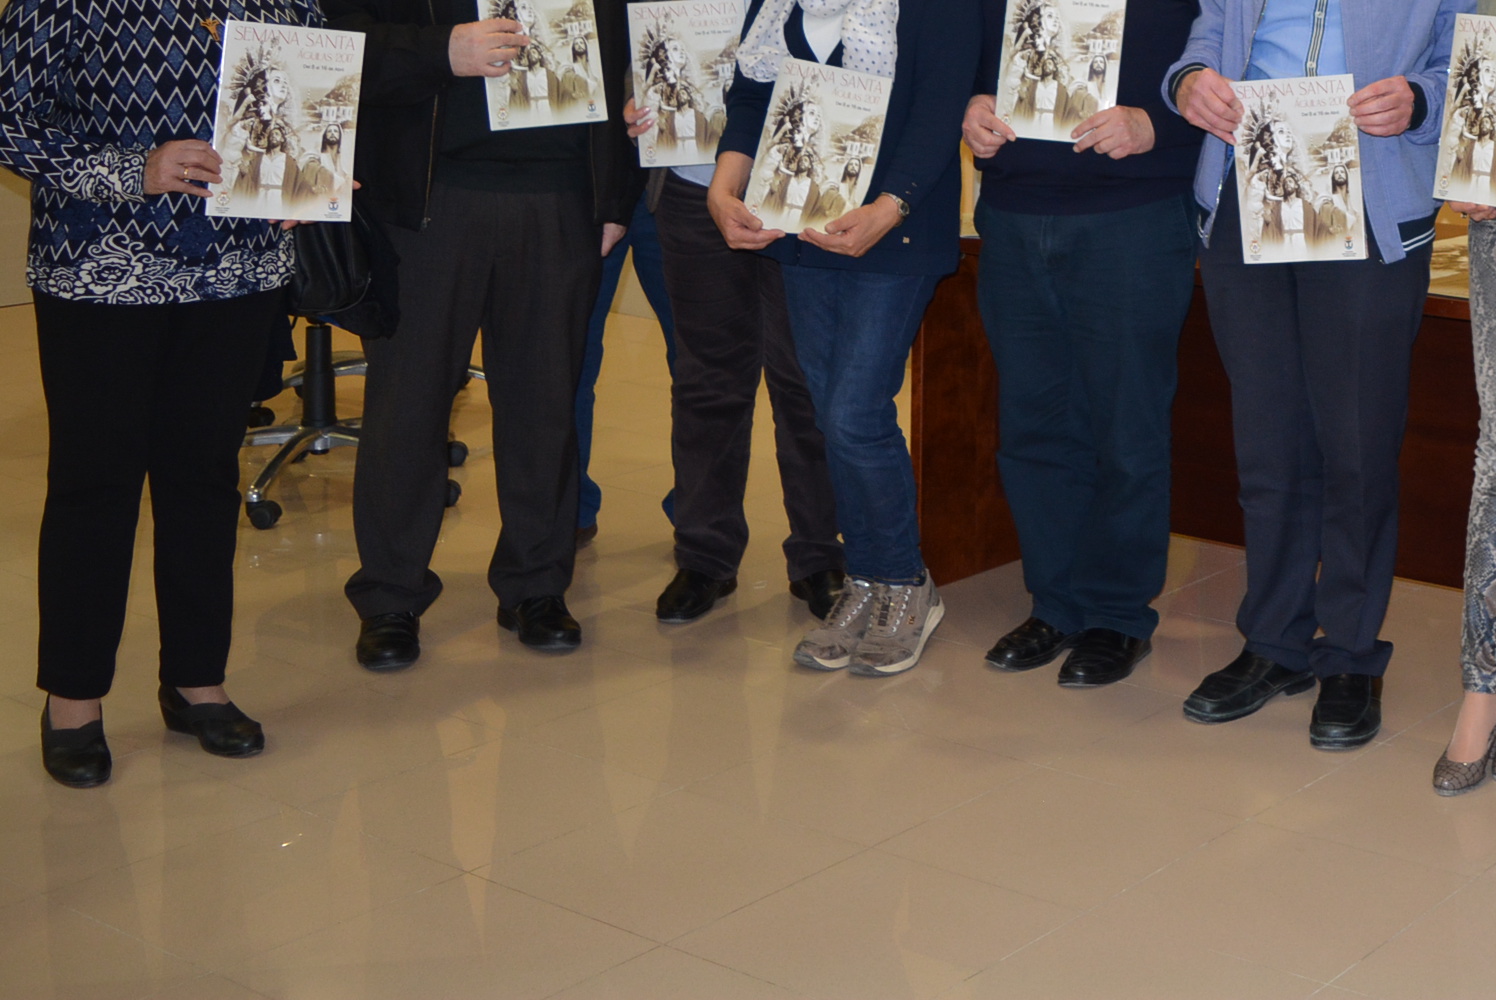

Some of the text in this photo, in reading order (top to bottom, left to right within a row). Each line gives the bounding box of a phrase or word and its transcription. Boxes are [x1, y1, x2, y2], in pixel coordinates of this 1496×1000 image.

[234, 26, 355, 51] SEMANA SANTA
[1236, 80, 1346, 99] SEMANA SANTA
